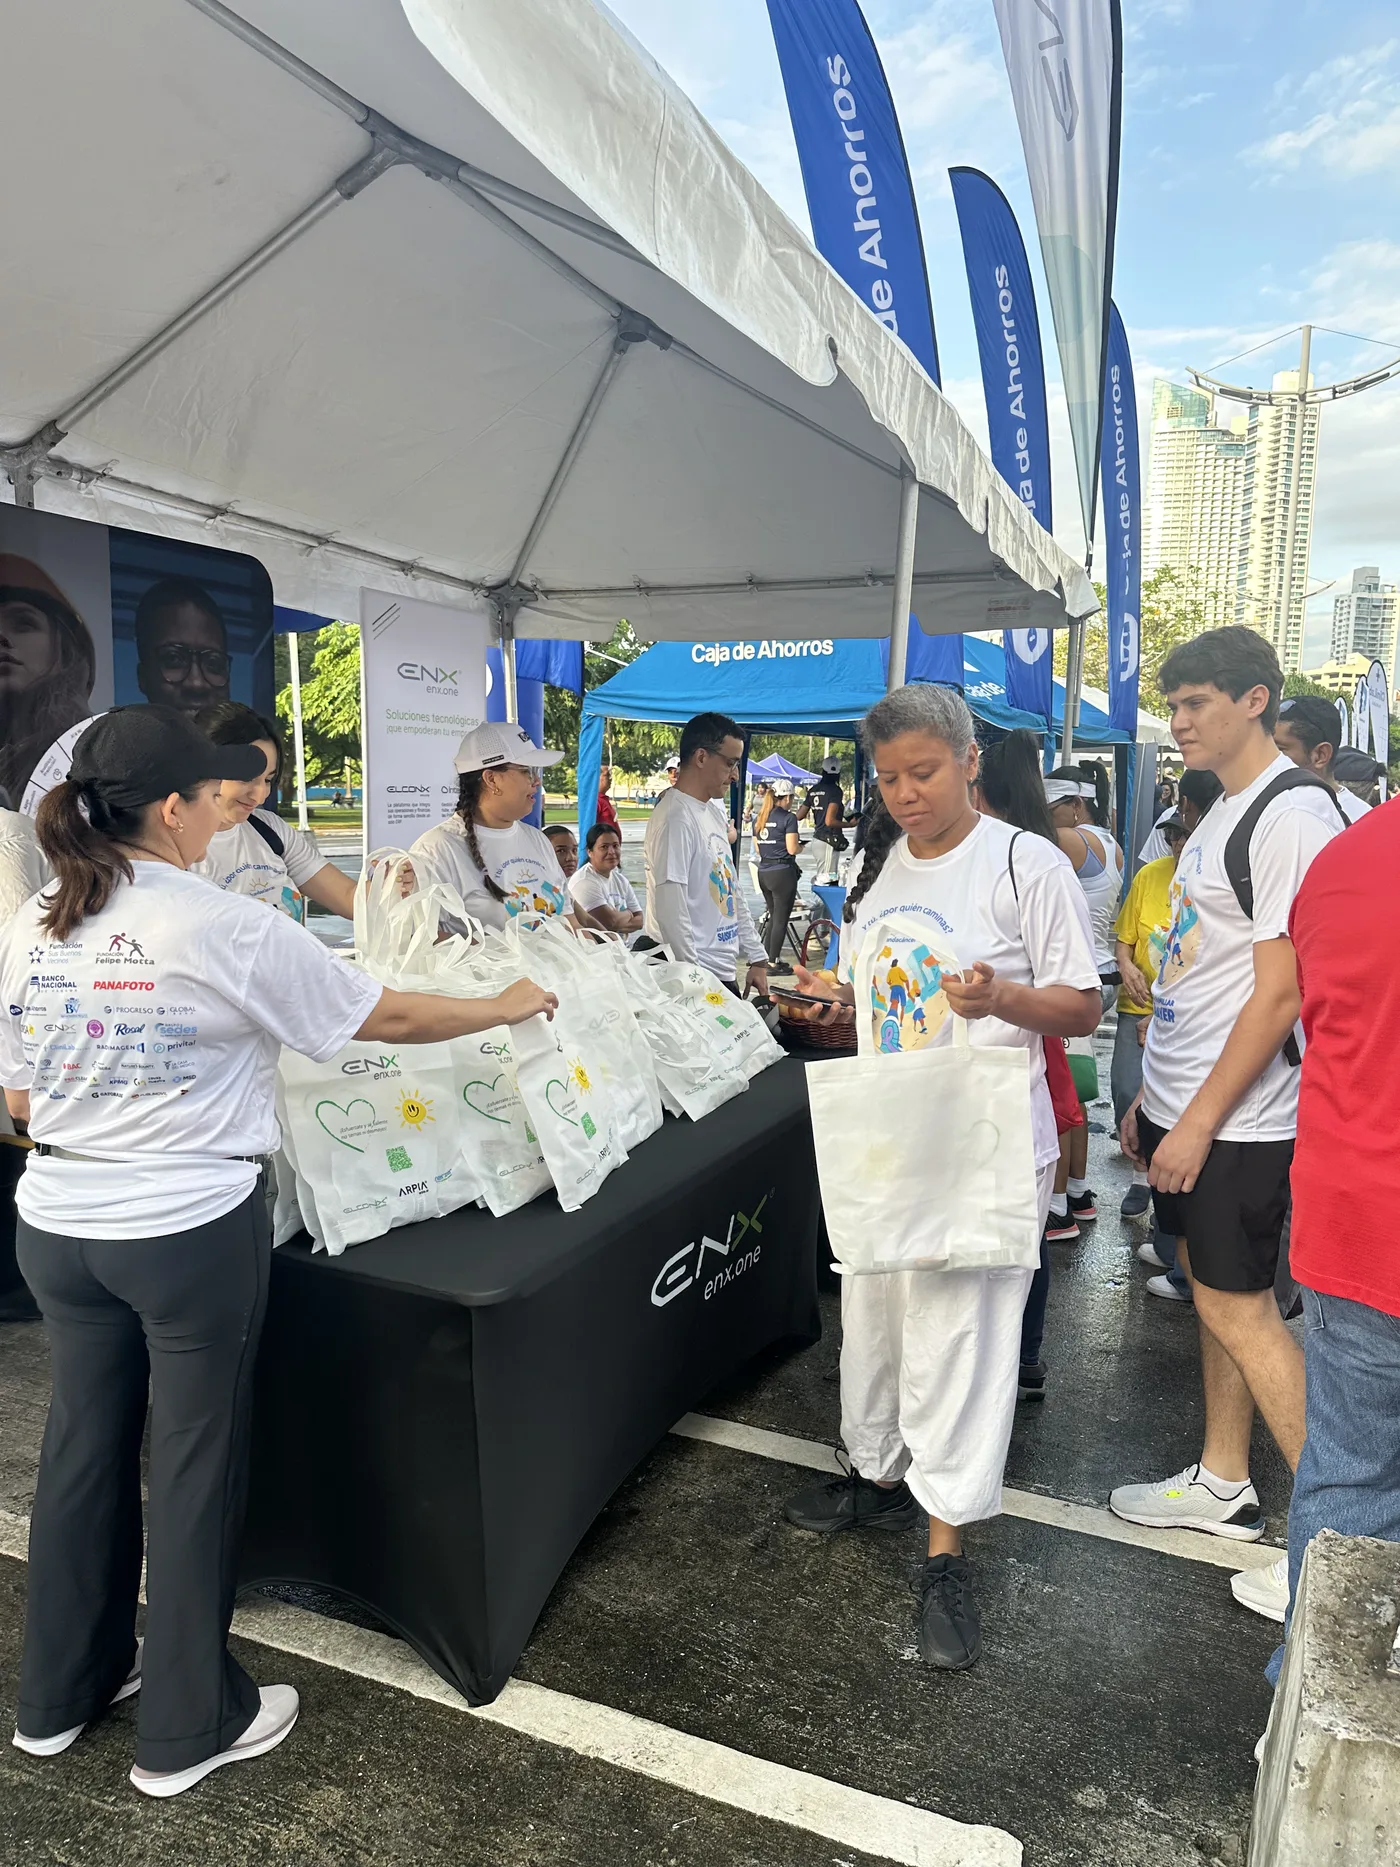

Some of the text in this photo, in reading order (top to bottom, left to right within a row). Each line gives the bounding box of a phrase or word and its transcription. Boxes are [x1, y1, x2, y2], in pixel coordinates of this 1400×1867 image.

[827, 53, 889, 270] Ahorros
[995, 264, 1027, 421] Ahorros
[1110, 364, 1129, 487] Ahorros
[1016, 427, 1031, 474] de
[1120, 492, 1131, 530] de
[691, 639, 834, 668] Caja de Ahorros
[397, 662, 458, 685] ENX
[426, 685, 459, 697] enx.one
[385, 708, 479, 728] Soluciones tecnológicas
[403, 726, 442, 736] empoderan
[443, 728, 450, 736] tu
[387, 785, 431, 794] ELCONX
[899, 902, 923, 913] quién
[922, 907, 954, 934] caminas?
[95, 957, 155, 965] Felipe Motta
[93, 980, 155, 991] PANAFOTO
[116, 1006, 153, 1014] PROGRESO
[44, 1024, 77, 1032] ENX
[160, 1023, 198, 1034] sedes
[342, 1054, 399, 1076] ENX
[373, 1069, 402, 1081] enx.one
[398, 1181, 428, 1198] ARPIA
[650, 1194, 768, 1308] ENX
[703, 1245, 762, 1301] enx.one
